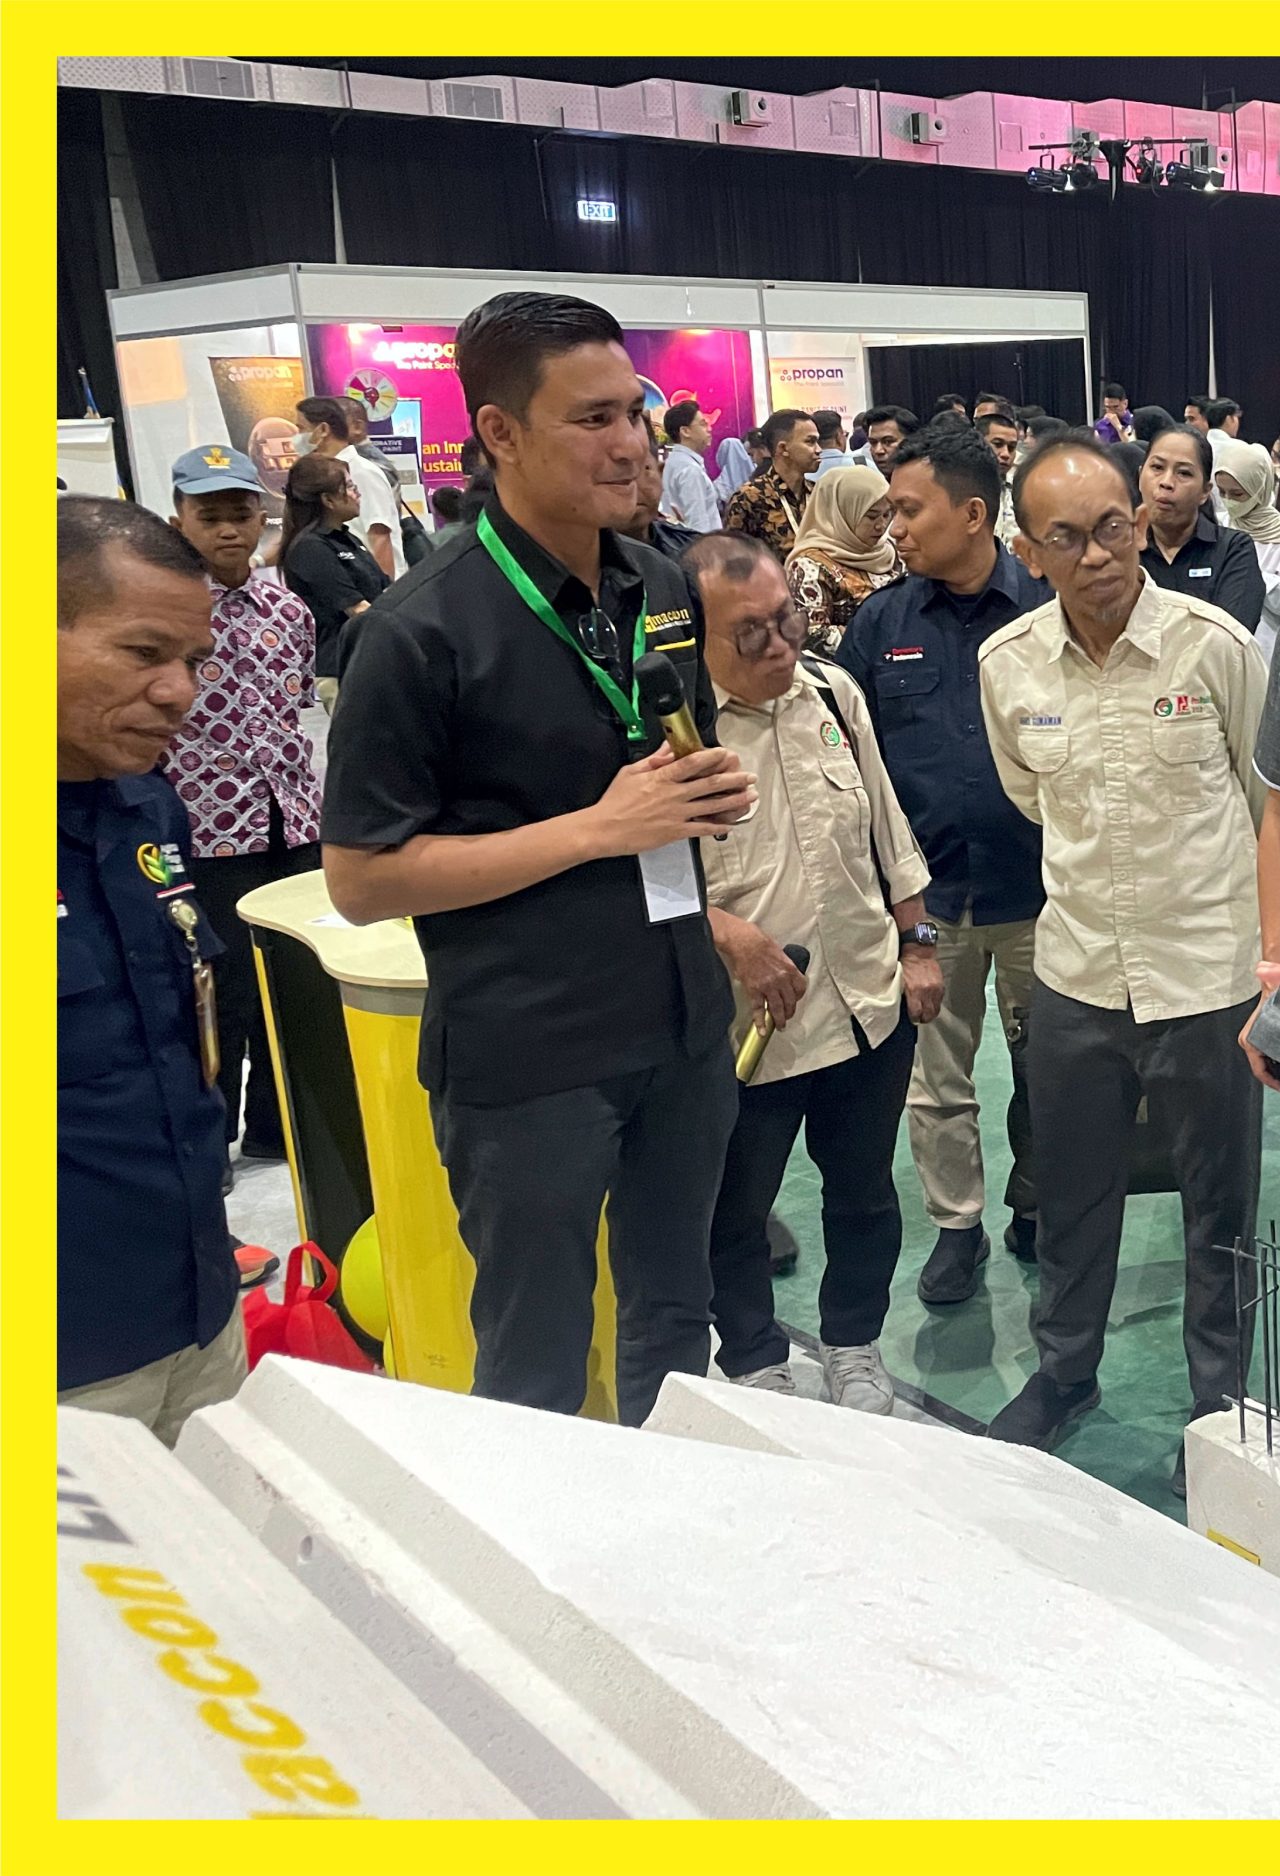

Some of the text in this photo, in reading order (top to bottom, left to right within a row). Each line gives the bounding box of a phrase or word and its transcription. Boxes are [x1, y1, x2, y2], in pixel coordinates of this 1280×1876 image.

[391, 341, 457, 361] propa
[792, 368, 844, 380] propan
[422, 459, 462, 473] ustai
[82, 1562, 380, 1820] accon
